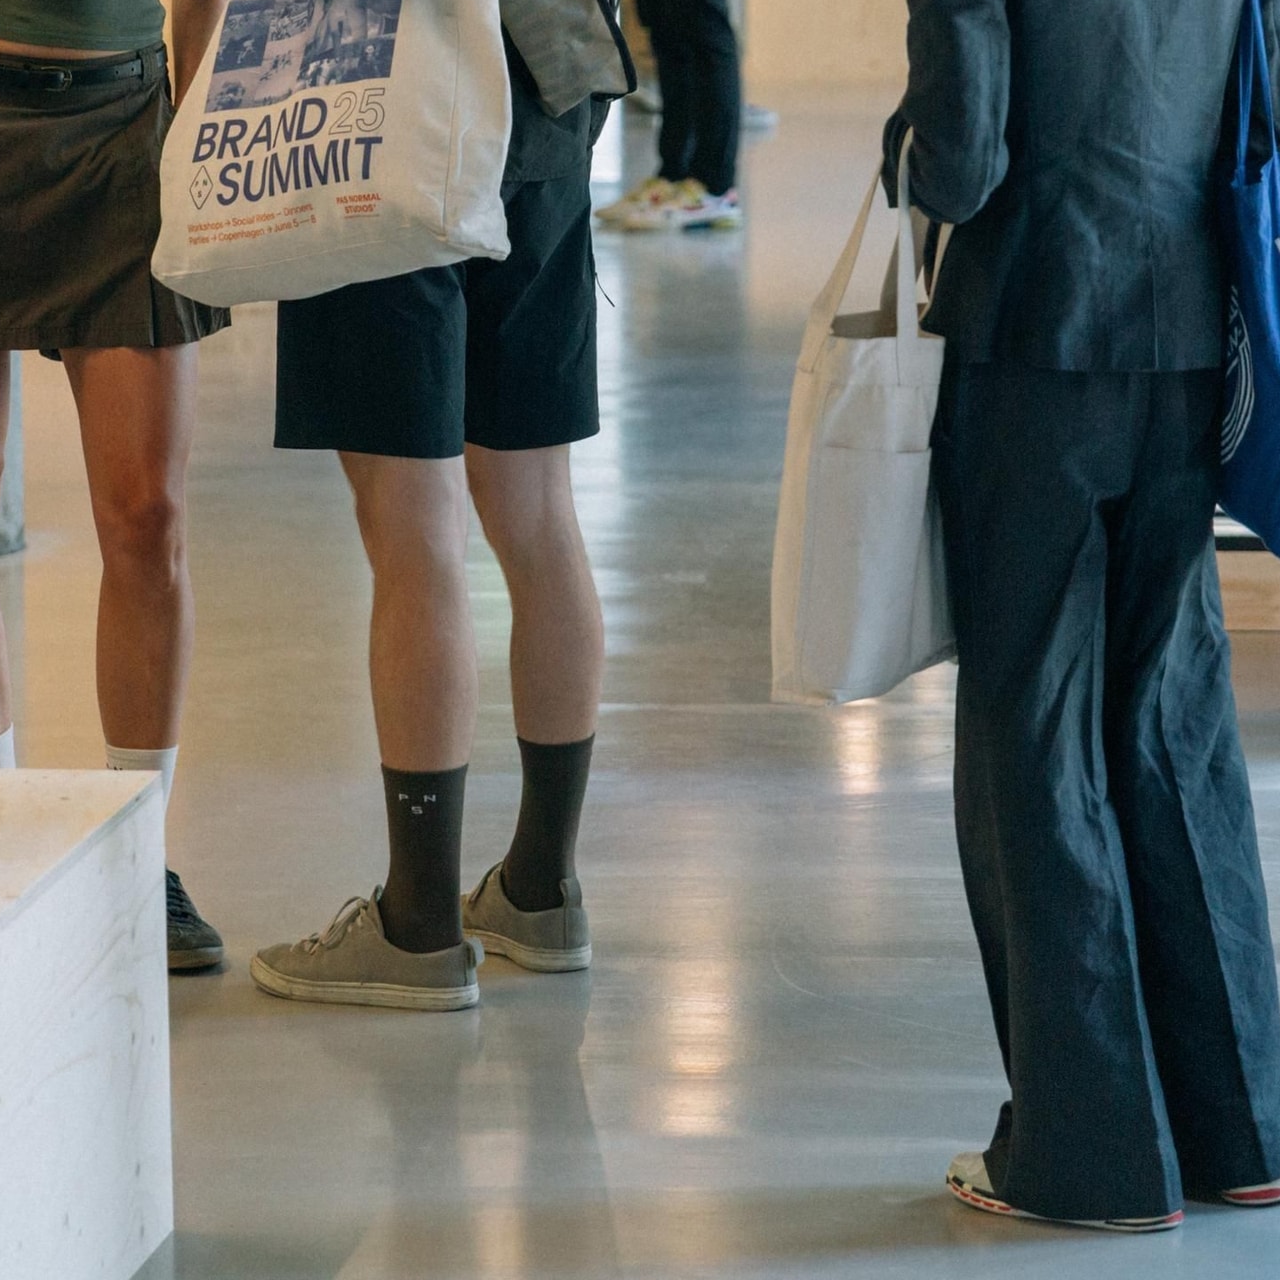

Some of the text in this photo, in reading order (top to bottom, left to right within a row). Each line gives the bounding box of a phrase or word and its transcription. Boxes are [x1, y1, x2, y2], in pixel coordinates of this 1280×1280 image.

[192, 87, 386, 163] BRAND 25
[216, 136, 384, 206] SUMMIT
[349, 192, 381, 202] NORMAL
[187, 221, 224, 232] Workshops
[231, 215, 256, 226] Social
[218, 228, 265, 243] Copenhagen
[274, 221, 293, 232] June
[423, 793, 437, 803] N
